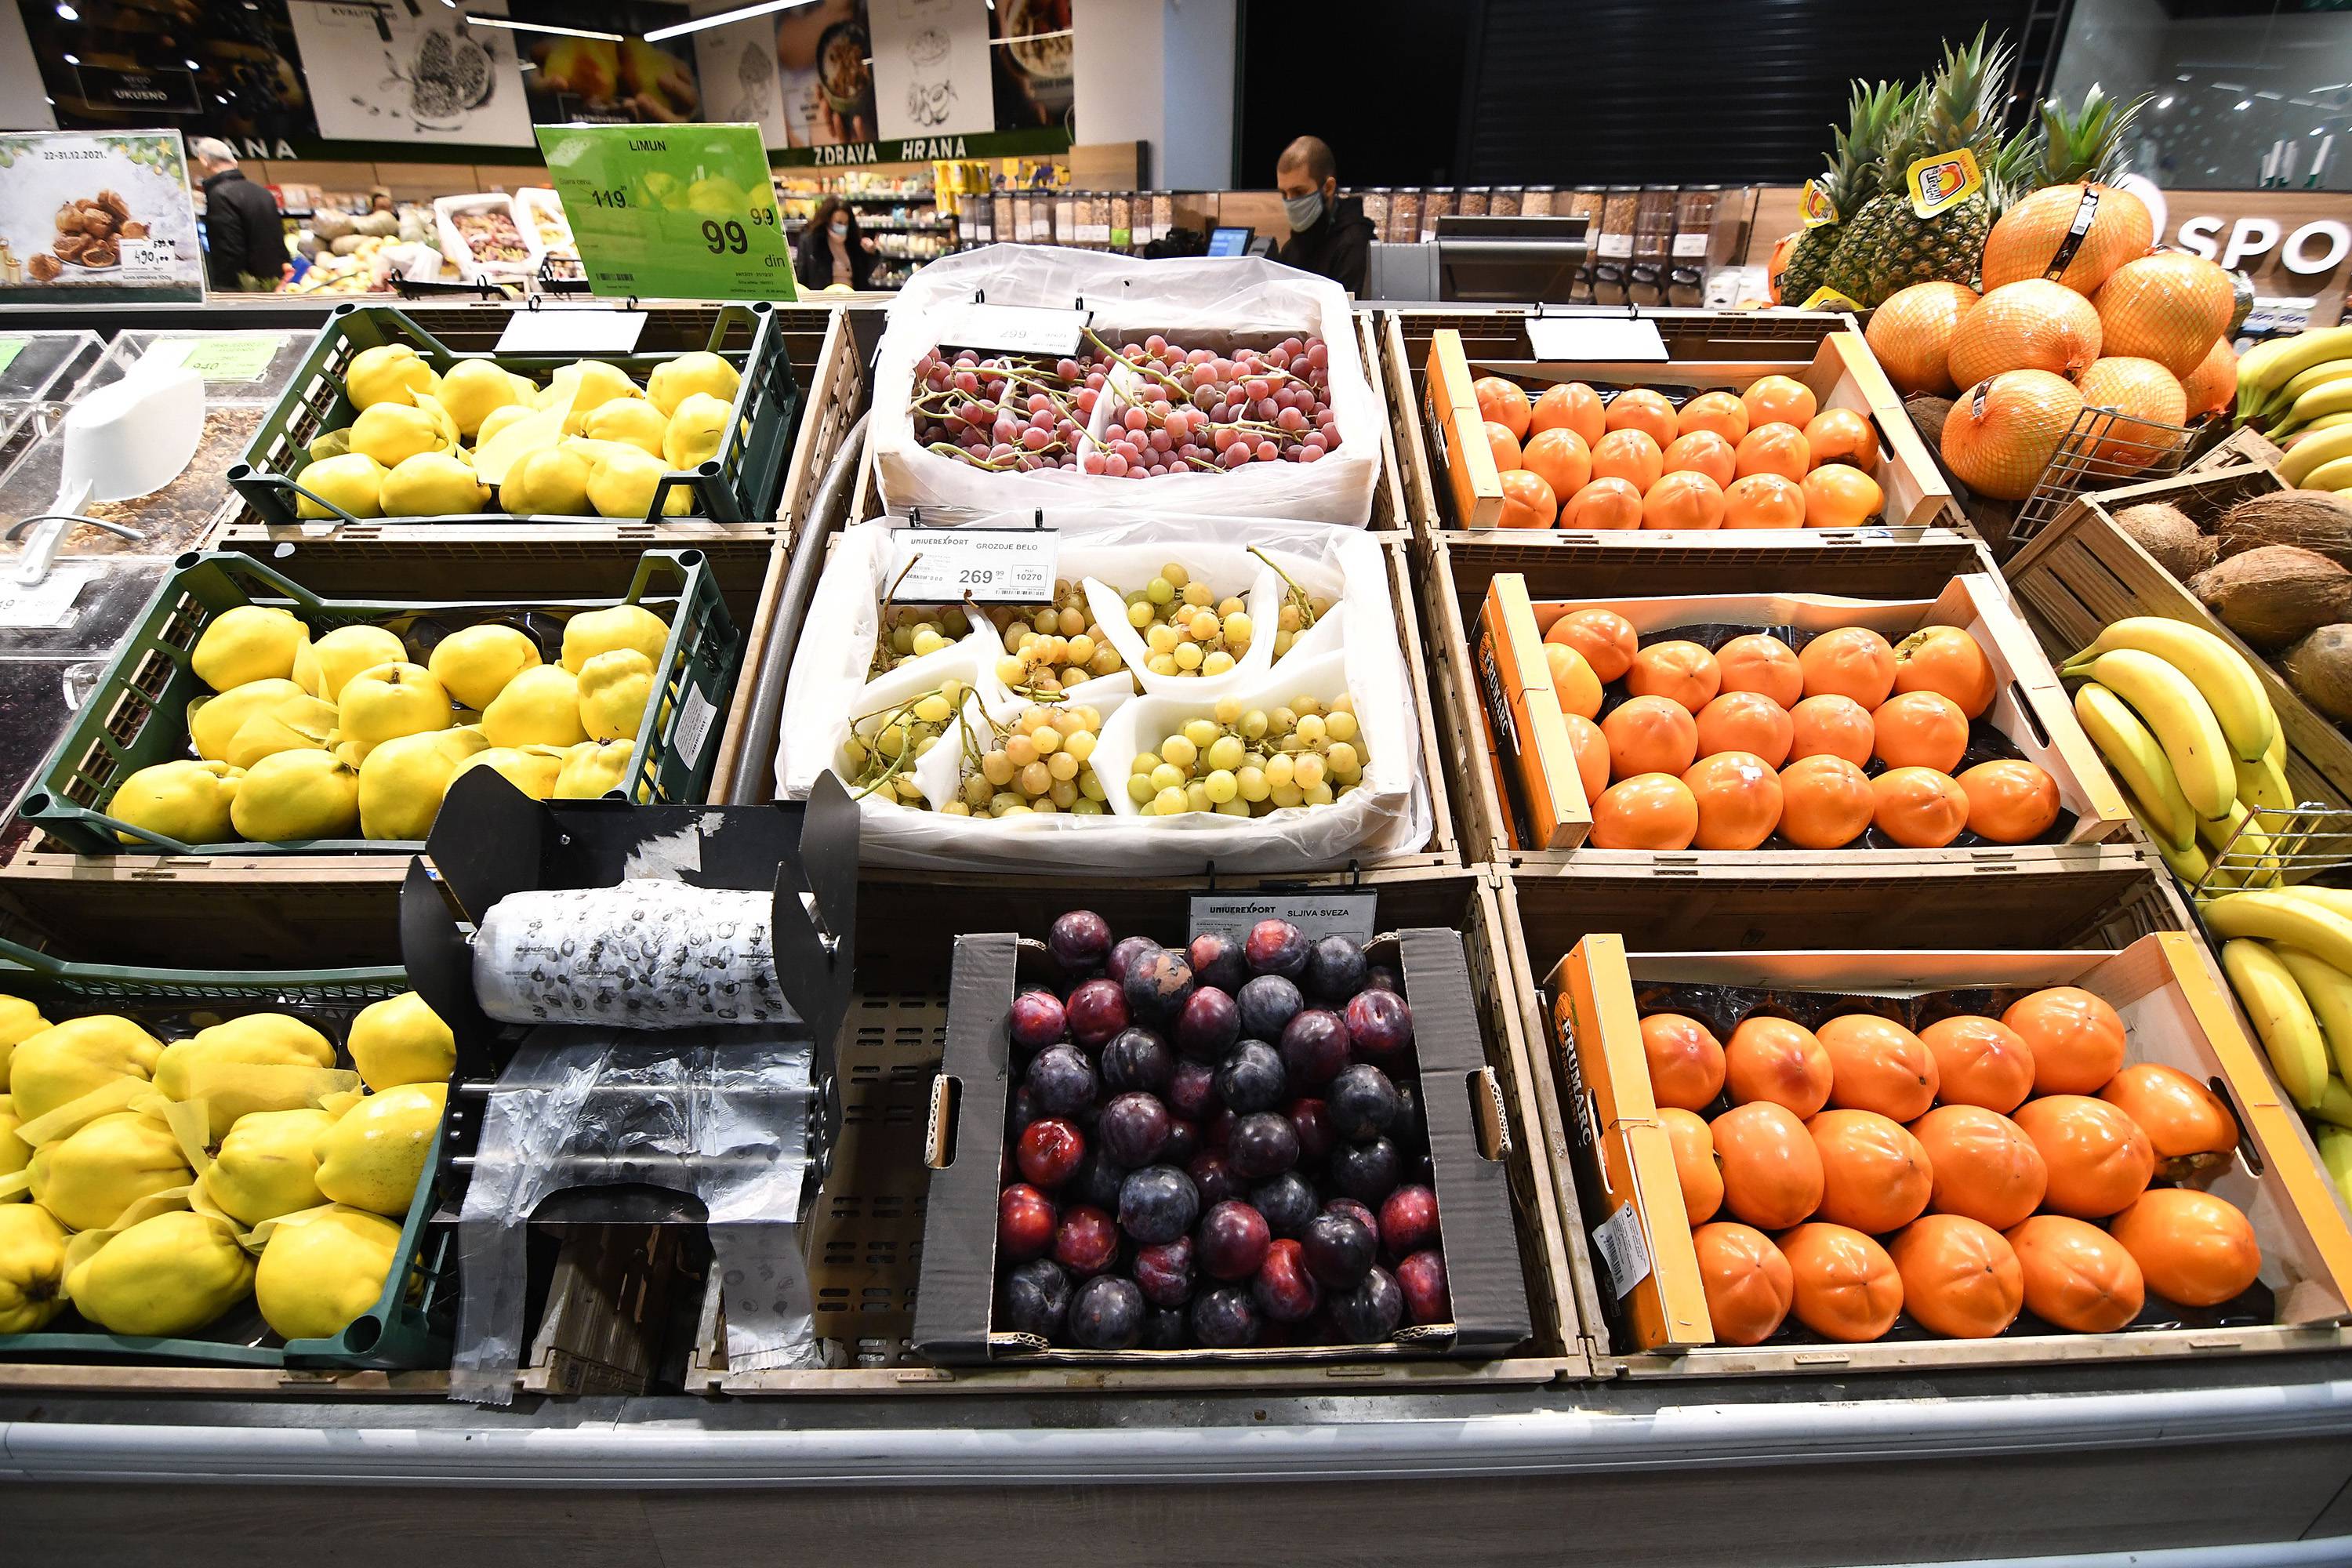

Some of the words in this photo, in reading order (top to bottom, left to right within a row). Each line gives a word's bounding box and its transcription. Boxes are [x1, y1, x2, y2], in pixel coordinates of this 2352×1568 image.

[629, 140, 667, 152] LIMUN
[814, 143, 877, 166] ZDRAVA
[901, 136, 967, 162] HRANA
[44, 151, 107, 161] 22-31.12.2021.
[592, 190, 626, 209] 119
[701, 220, 748, 256] 99
[750, 208, 775, 227] 99
[764, 254, 786, 268] din
[910, 535, 969, 546] UNIVEREXPORT
[959, 570, 993, 583] 269
[1484, 649, 1508, 736] FRUMARC
[1210, 902, 1276, 913] UNIVEREXPORT
[1562, 1018, 1592, 1146] FRUMARC
